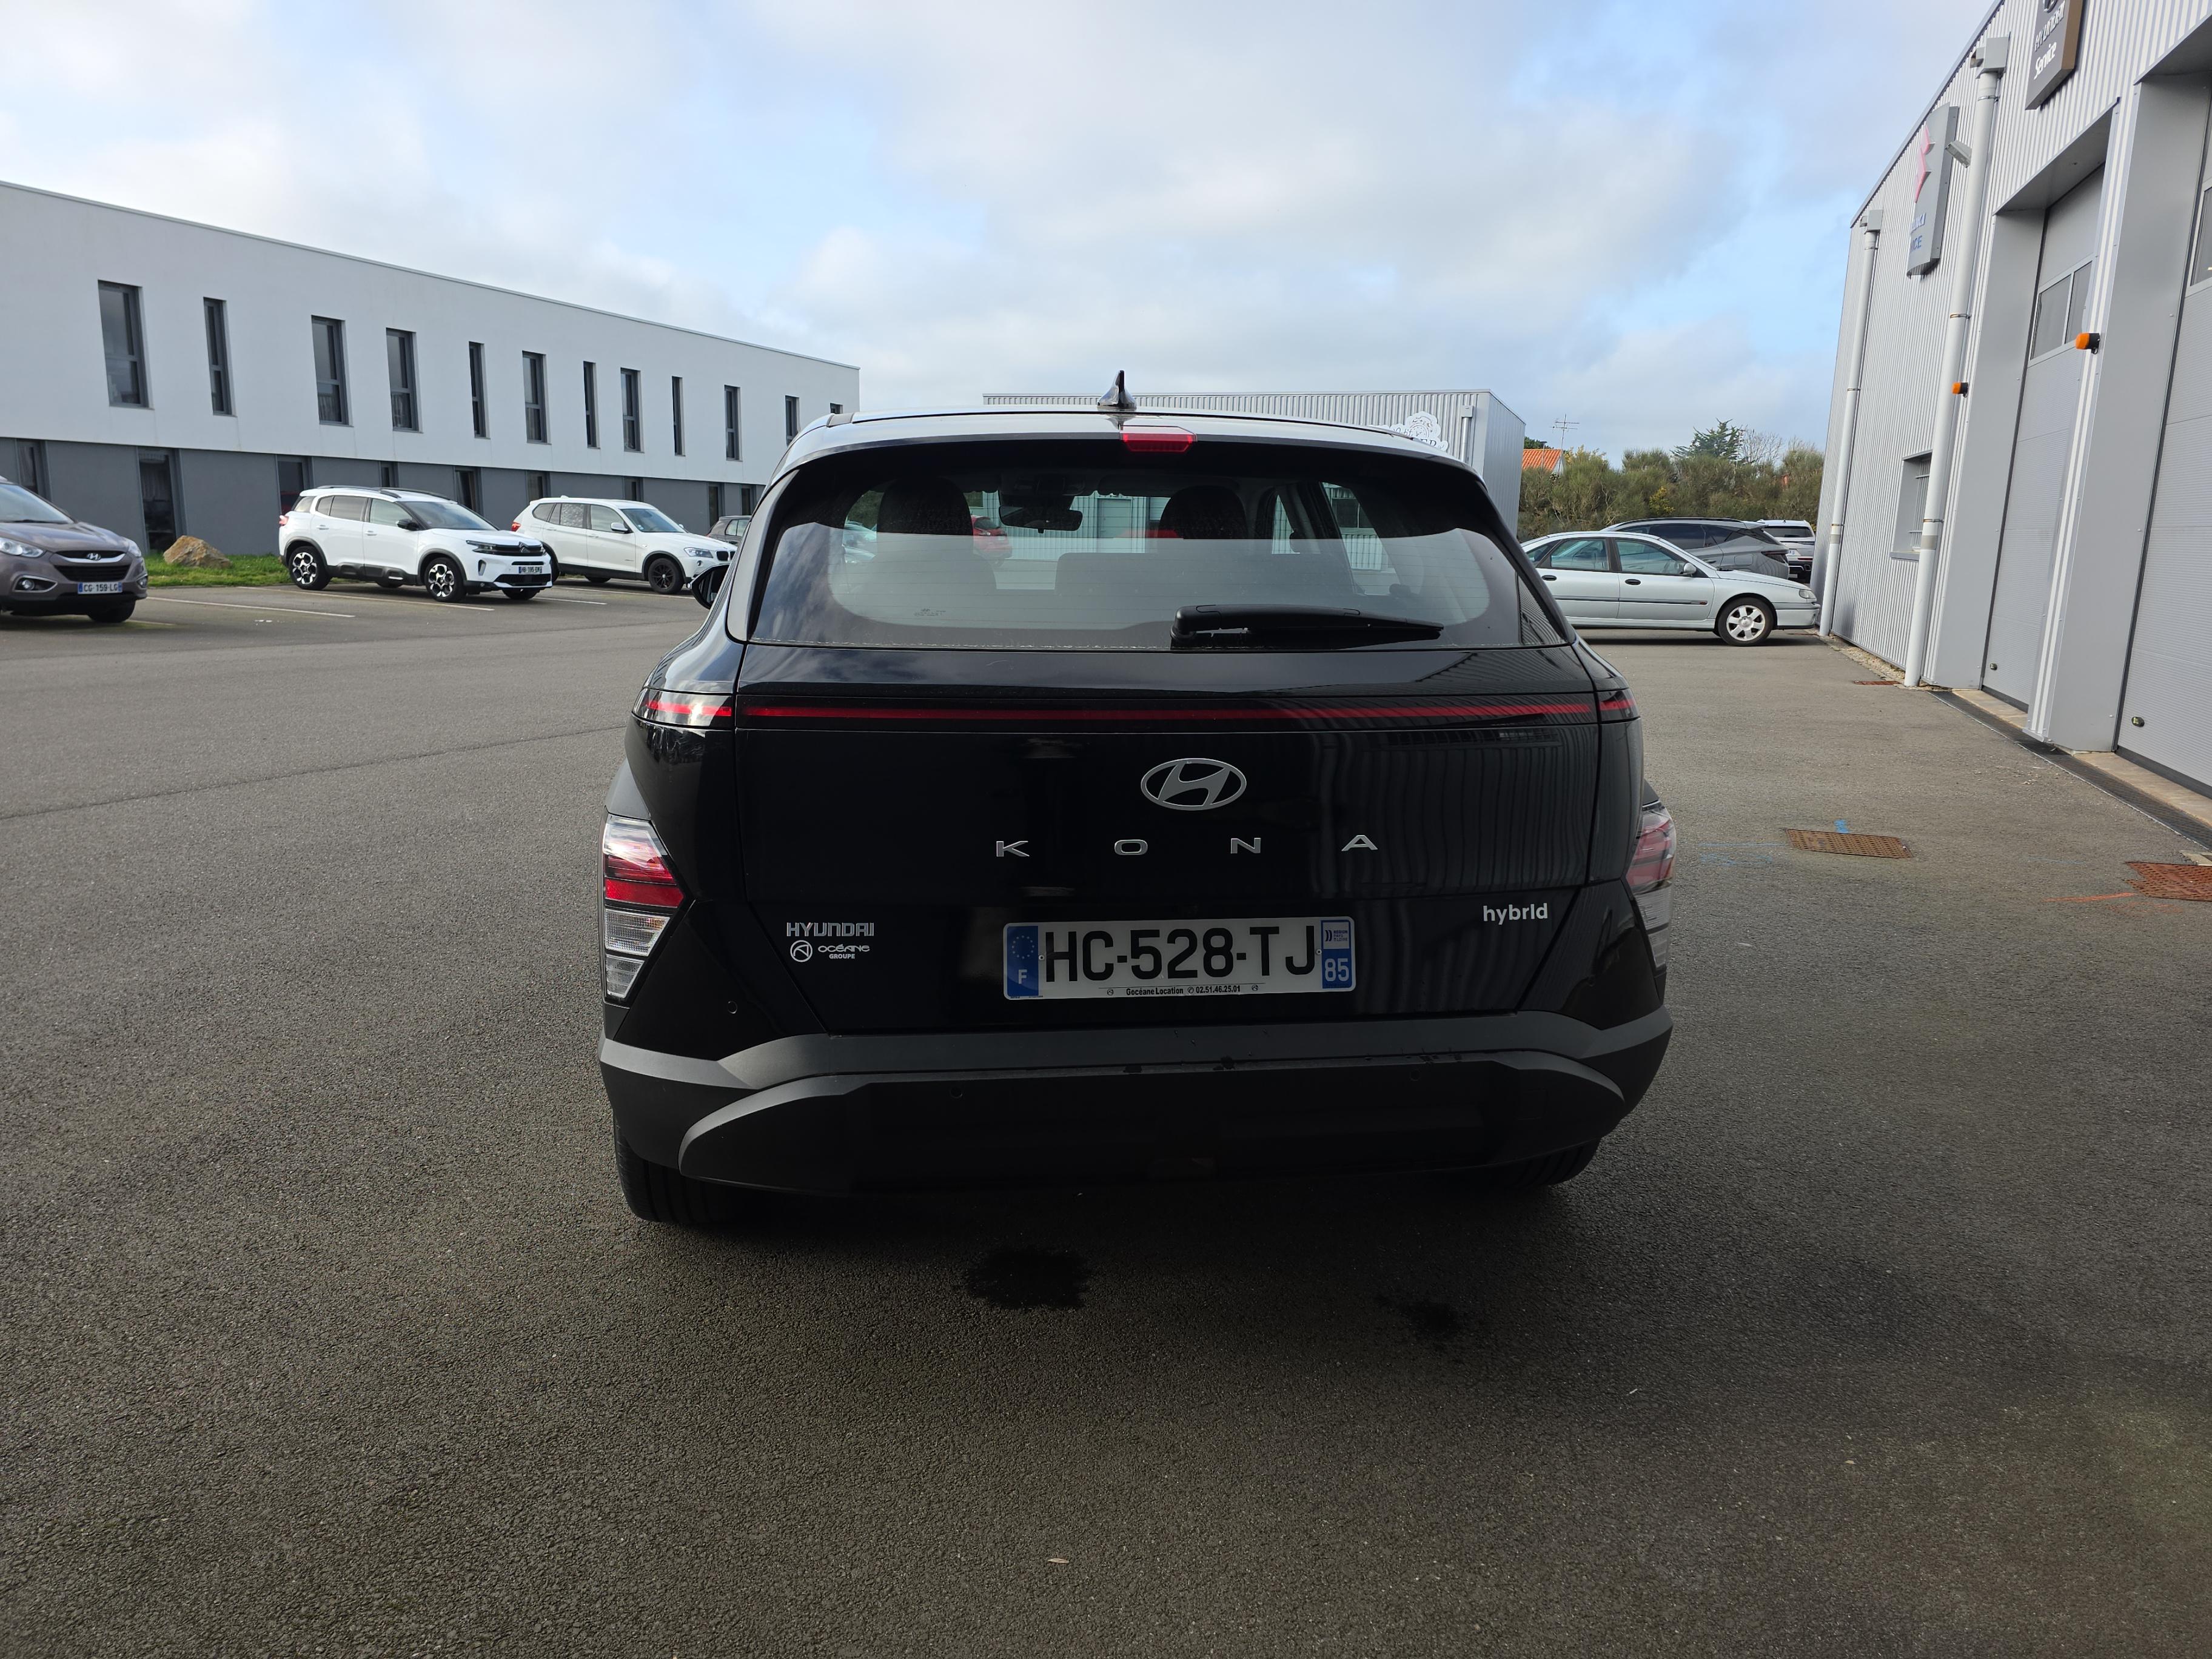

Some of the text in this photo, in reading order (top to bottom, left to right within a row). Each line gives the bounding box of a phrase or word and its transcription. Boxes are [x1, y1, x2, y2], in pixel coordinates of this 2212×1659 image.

[2033, 42, 2057, 79] Service
[996, 834, 1378, 857] KONA
[1483, 902, 1548, 925] hybrid
[786, 922, 874, 937] HYUNDAI
[1045, 925, 1315, 982] HC-528-TJ
[1018, 969, 1028, 985] F
[1324, 958, 1349, 982] 85
[1126, 985, 1241, 996] Gocéane Location 02.51.46.25.01
